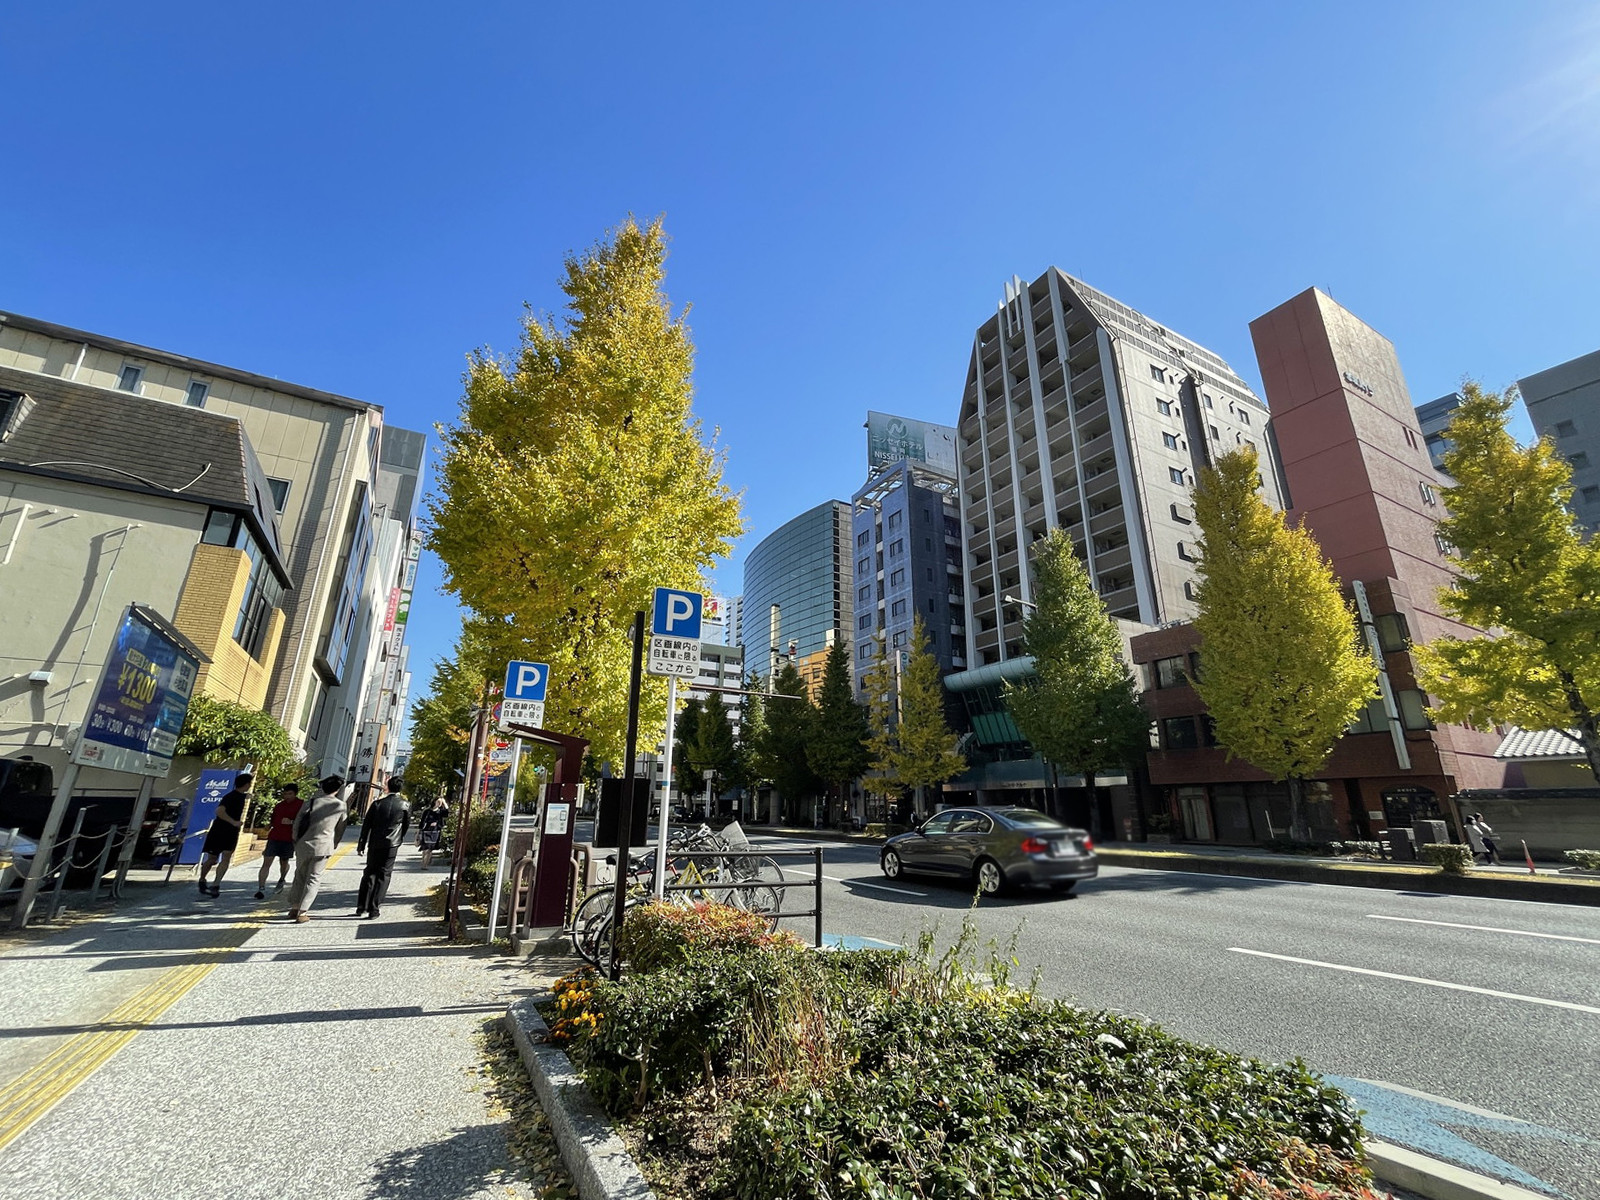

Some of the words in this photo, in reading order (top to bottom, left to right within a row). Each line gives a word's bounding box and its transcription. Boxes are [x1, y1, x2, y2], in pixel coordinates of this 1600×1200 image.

[874, 450, 898, 461] NISSEI
[665, 593, 694, 632] P
[654, 638, 698, 652] 区画線内の
[653, 648, 697, 662] 自転車に限る
[655, 661, 694, 674] ここから
[117, 662, 158, 704] ¥1300
[515, 665, 541, 696] P
[504, 702, 541, 712] 区画線内の
[503, 710, 540, 720] 自転車に限る
[205, 779, 230, 787] Asahi
